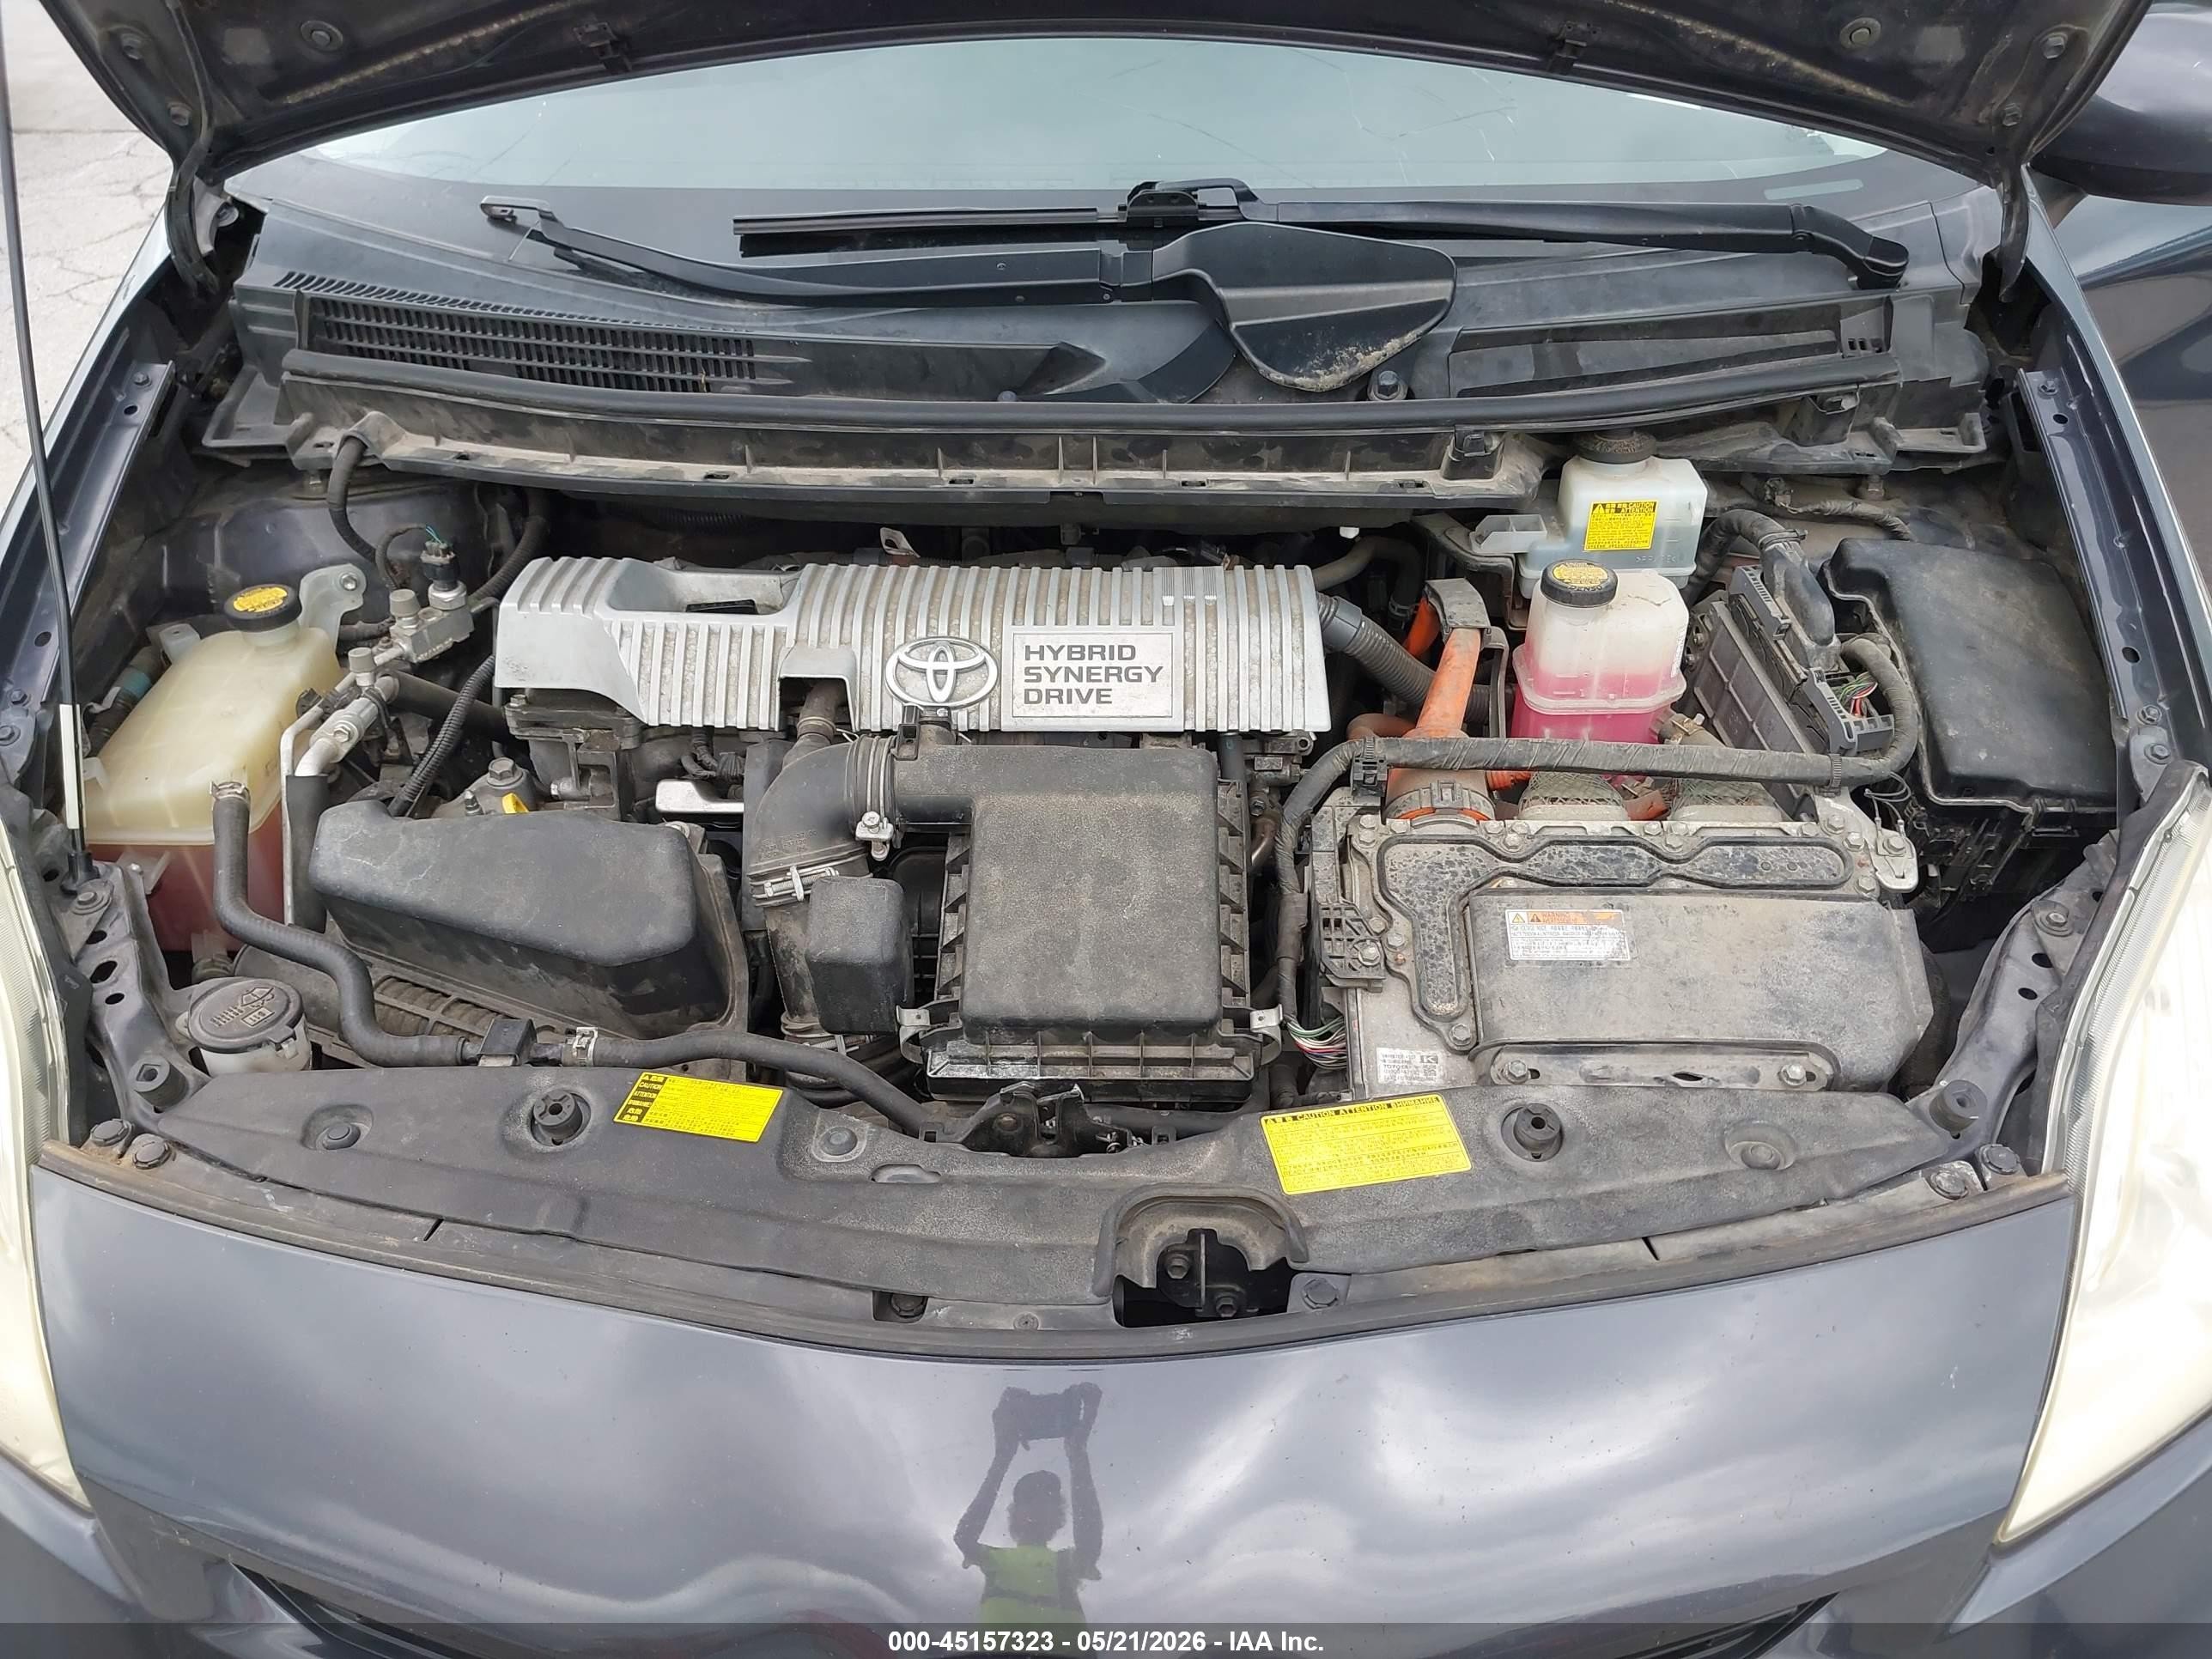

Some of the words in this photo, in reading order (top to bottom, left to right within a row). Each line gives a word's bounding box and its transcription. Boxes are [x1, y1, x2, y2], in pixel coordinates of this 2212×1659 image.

[1024, 645, 1135, 660] HYBRID
[1024, 666, 1164, 683] SYNERGY
[1024, 688, 1112, 704] DRIVE
[638, 1082, 664, 1091] CAUTION
[1297, 1110, 1335, 1121] CAUTION
[1340, 1103, 1388, 1115] ATTENTION
